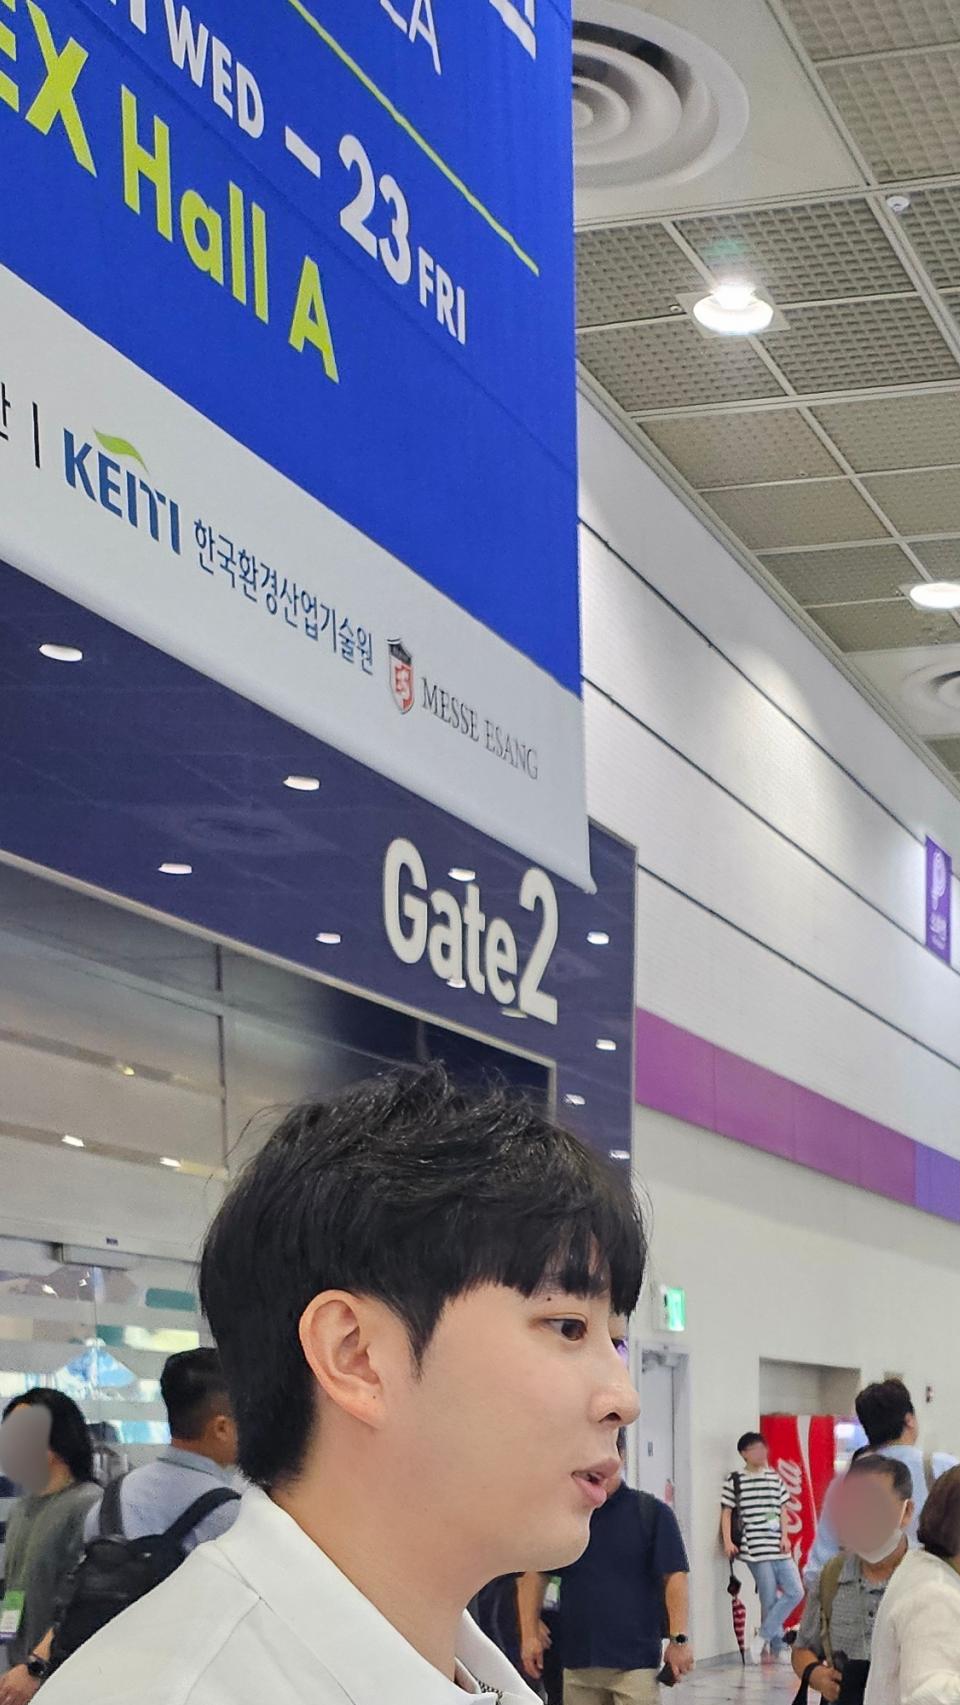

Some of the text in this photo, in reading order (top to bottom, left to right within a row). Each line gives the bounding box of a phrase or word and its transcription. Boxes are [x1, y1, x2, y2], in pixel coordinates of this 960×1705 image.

[121, 84, 268, 324] Hall
[289, 255, 339, 383] A
[164, 0, 264, 138] WED
[338, 134, 411, 285] 23
[418, 246, 465, 345] FRI
[63, 427, 181, 556] KEITI
[194, 518, 373, 675] 한국환경산업기술원
[421, 676, 538, 780] MESSE ESANG
